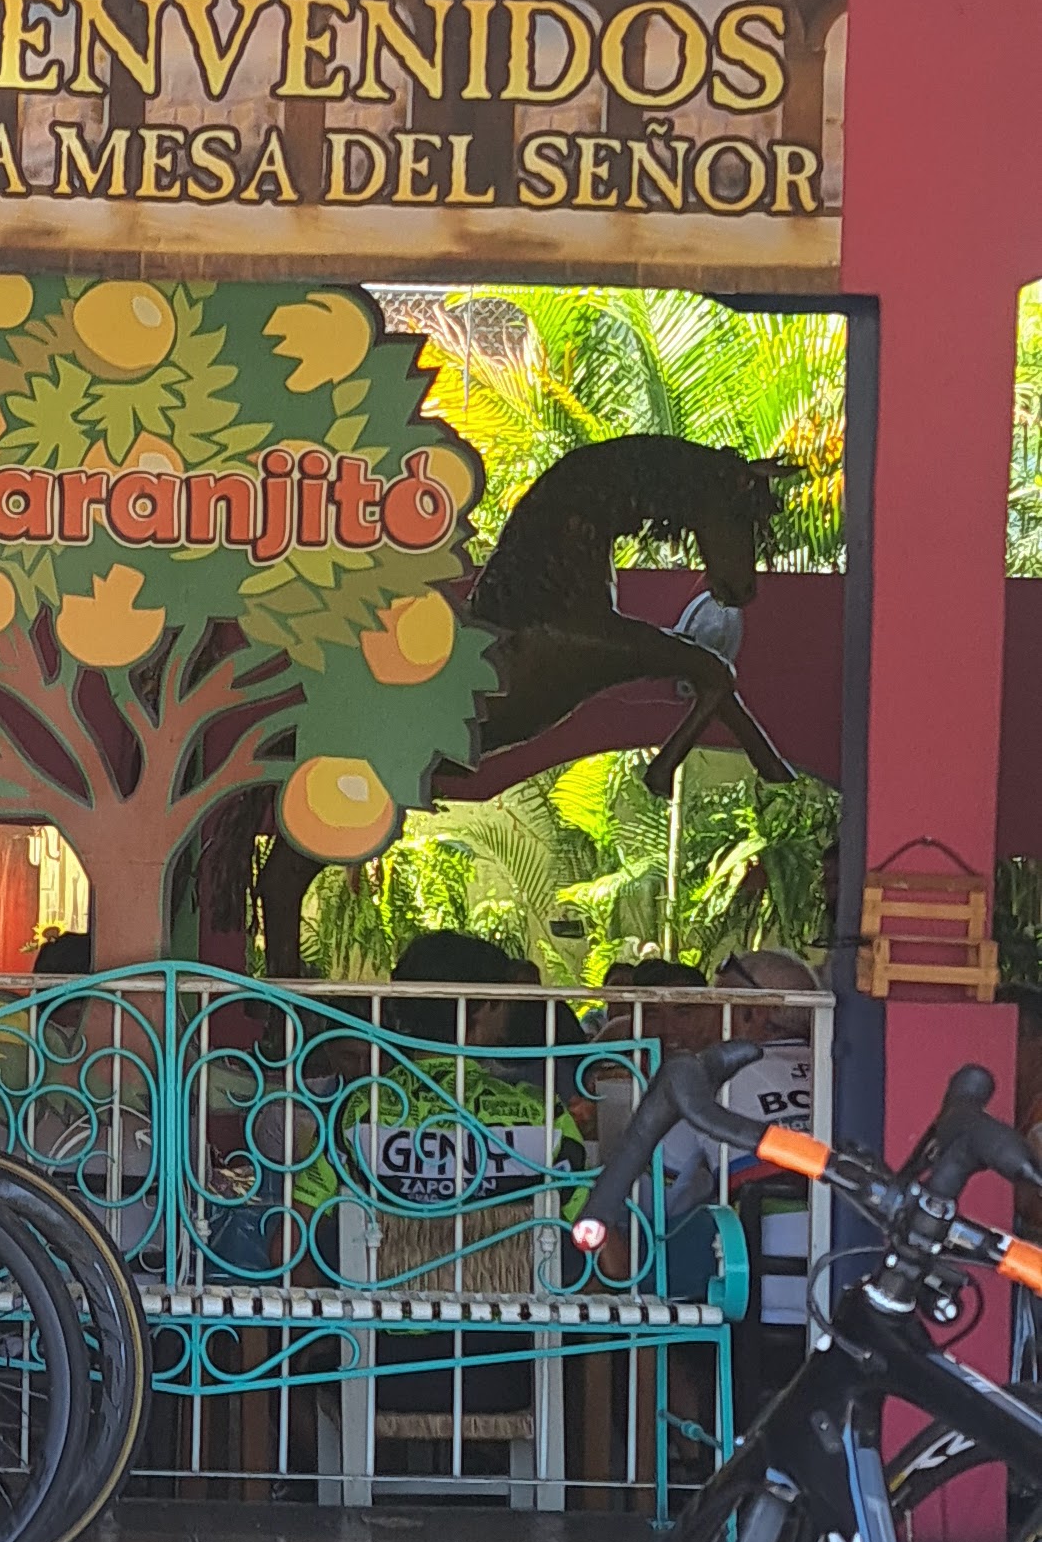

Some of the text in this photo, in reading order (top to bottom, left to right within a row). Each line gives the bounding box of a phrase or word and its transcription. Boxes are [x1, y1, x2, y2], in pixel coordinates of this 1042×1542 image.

[53, 125, 300, 203] MESA
[324, 131, 495, 206] DEL
[517, 121, 820, 213] SEÑOR
[399, 1177, 497, 1197] ZAPON
